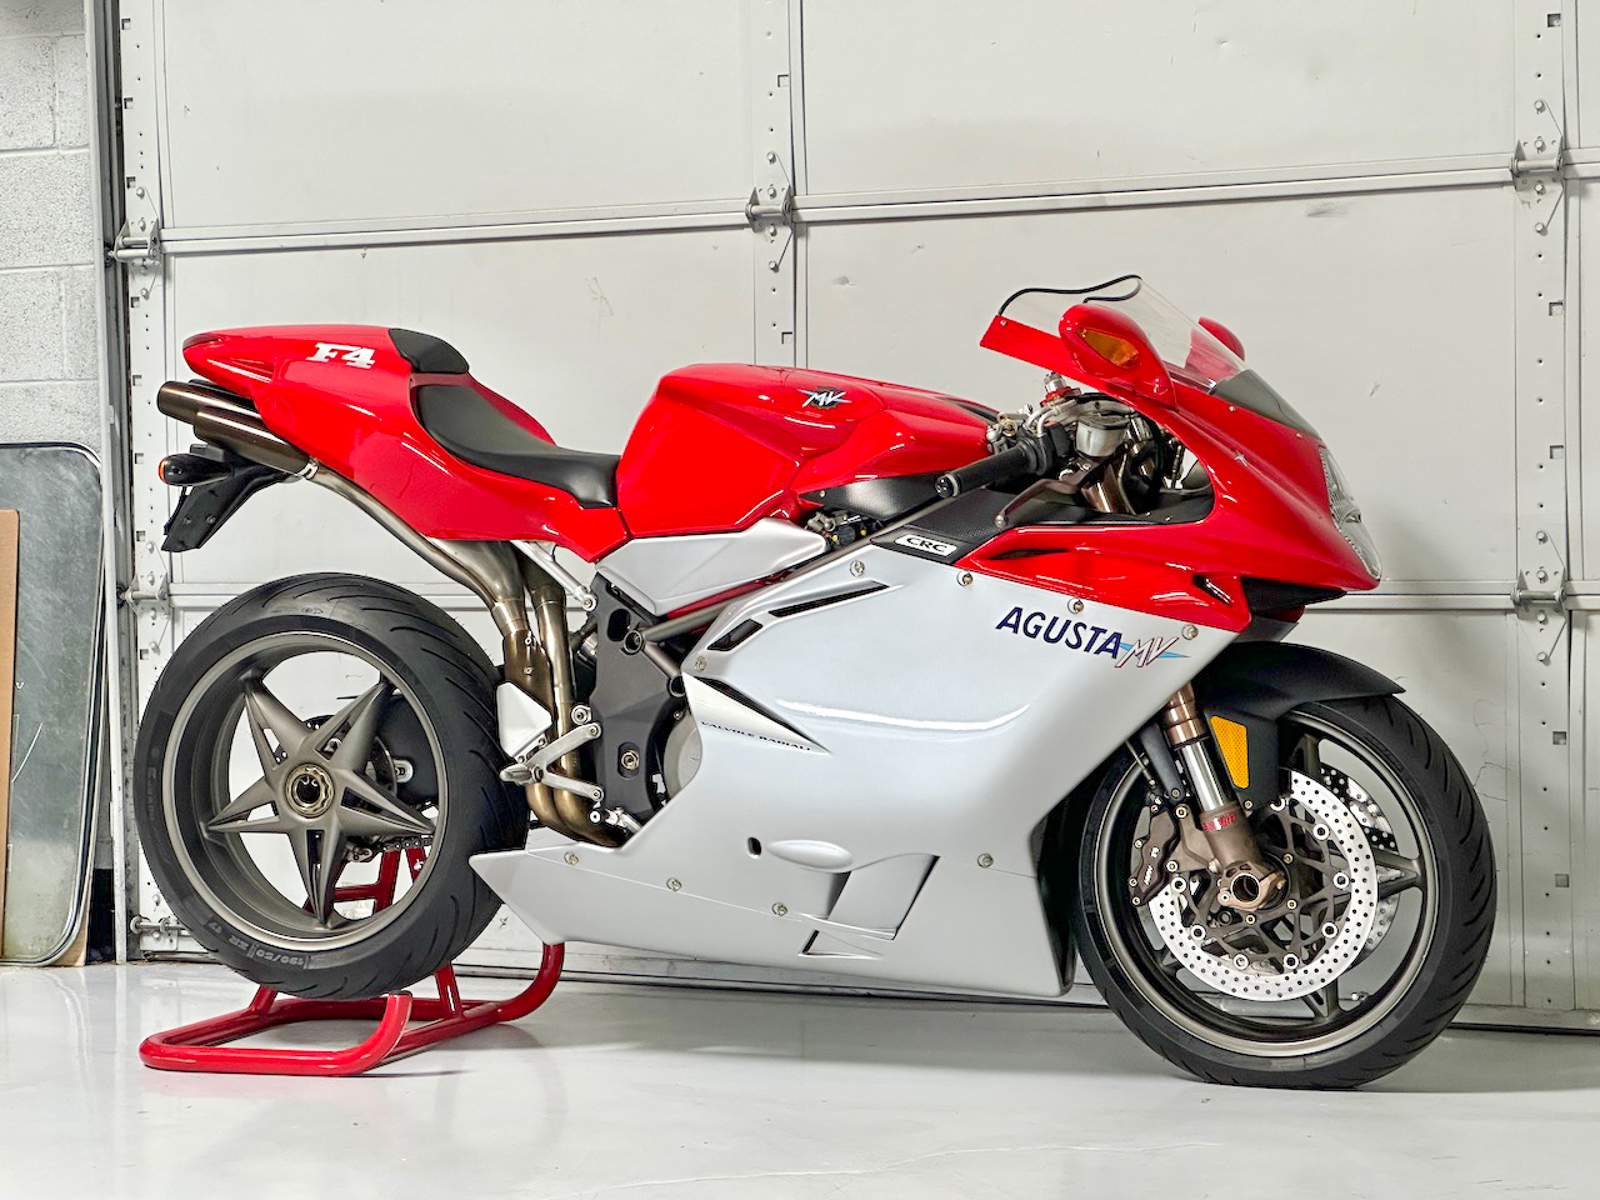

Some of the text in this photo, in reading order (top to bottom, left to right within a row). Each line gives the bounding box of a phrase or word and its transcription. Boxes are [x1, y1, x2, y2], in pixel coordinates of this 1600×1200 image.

[304, 341, 376, 370] F4
[802, 391, 847, 408] MV
[906, 537, 948, 553] CRC
[995, 606, 1180, 668] AGUSTA MV
